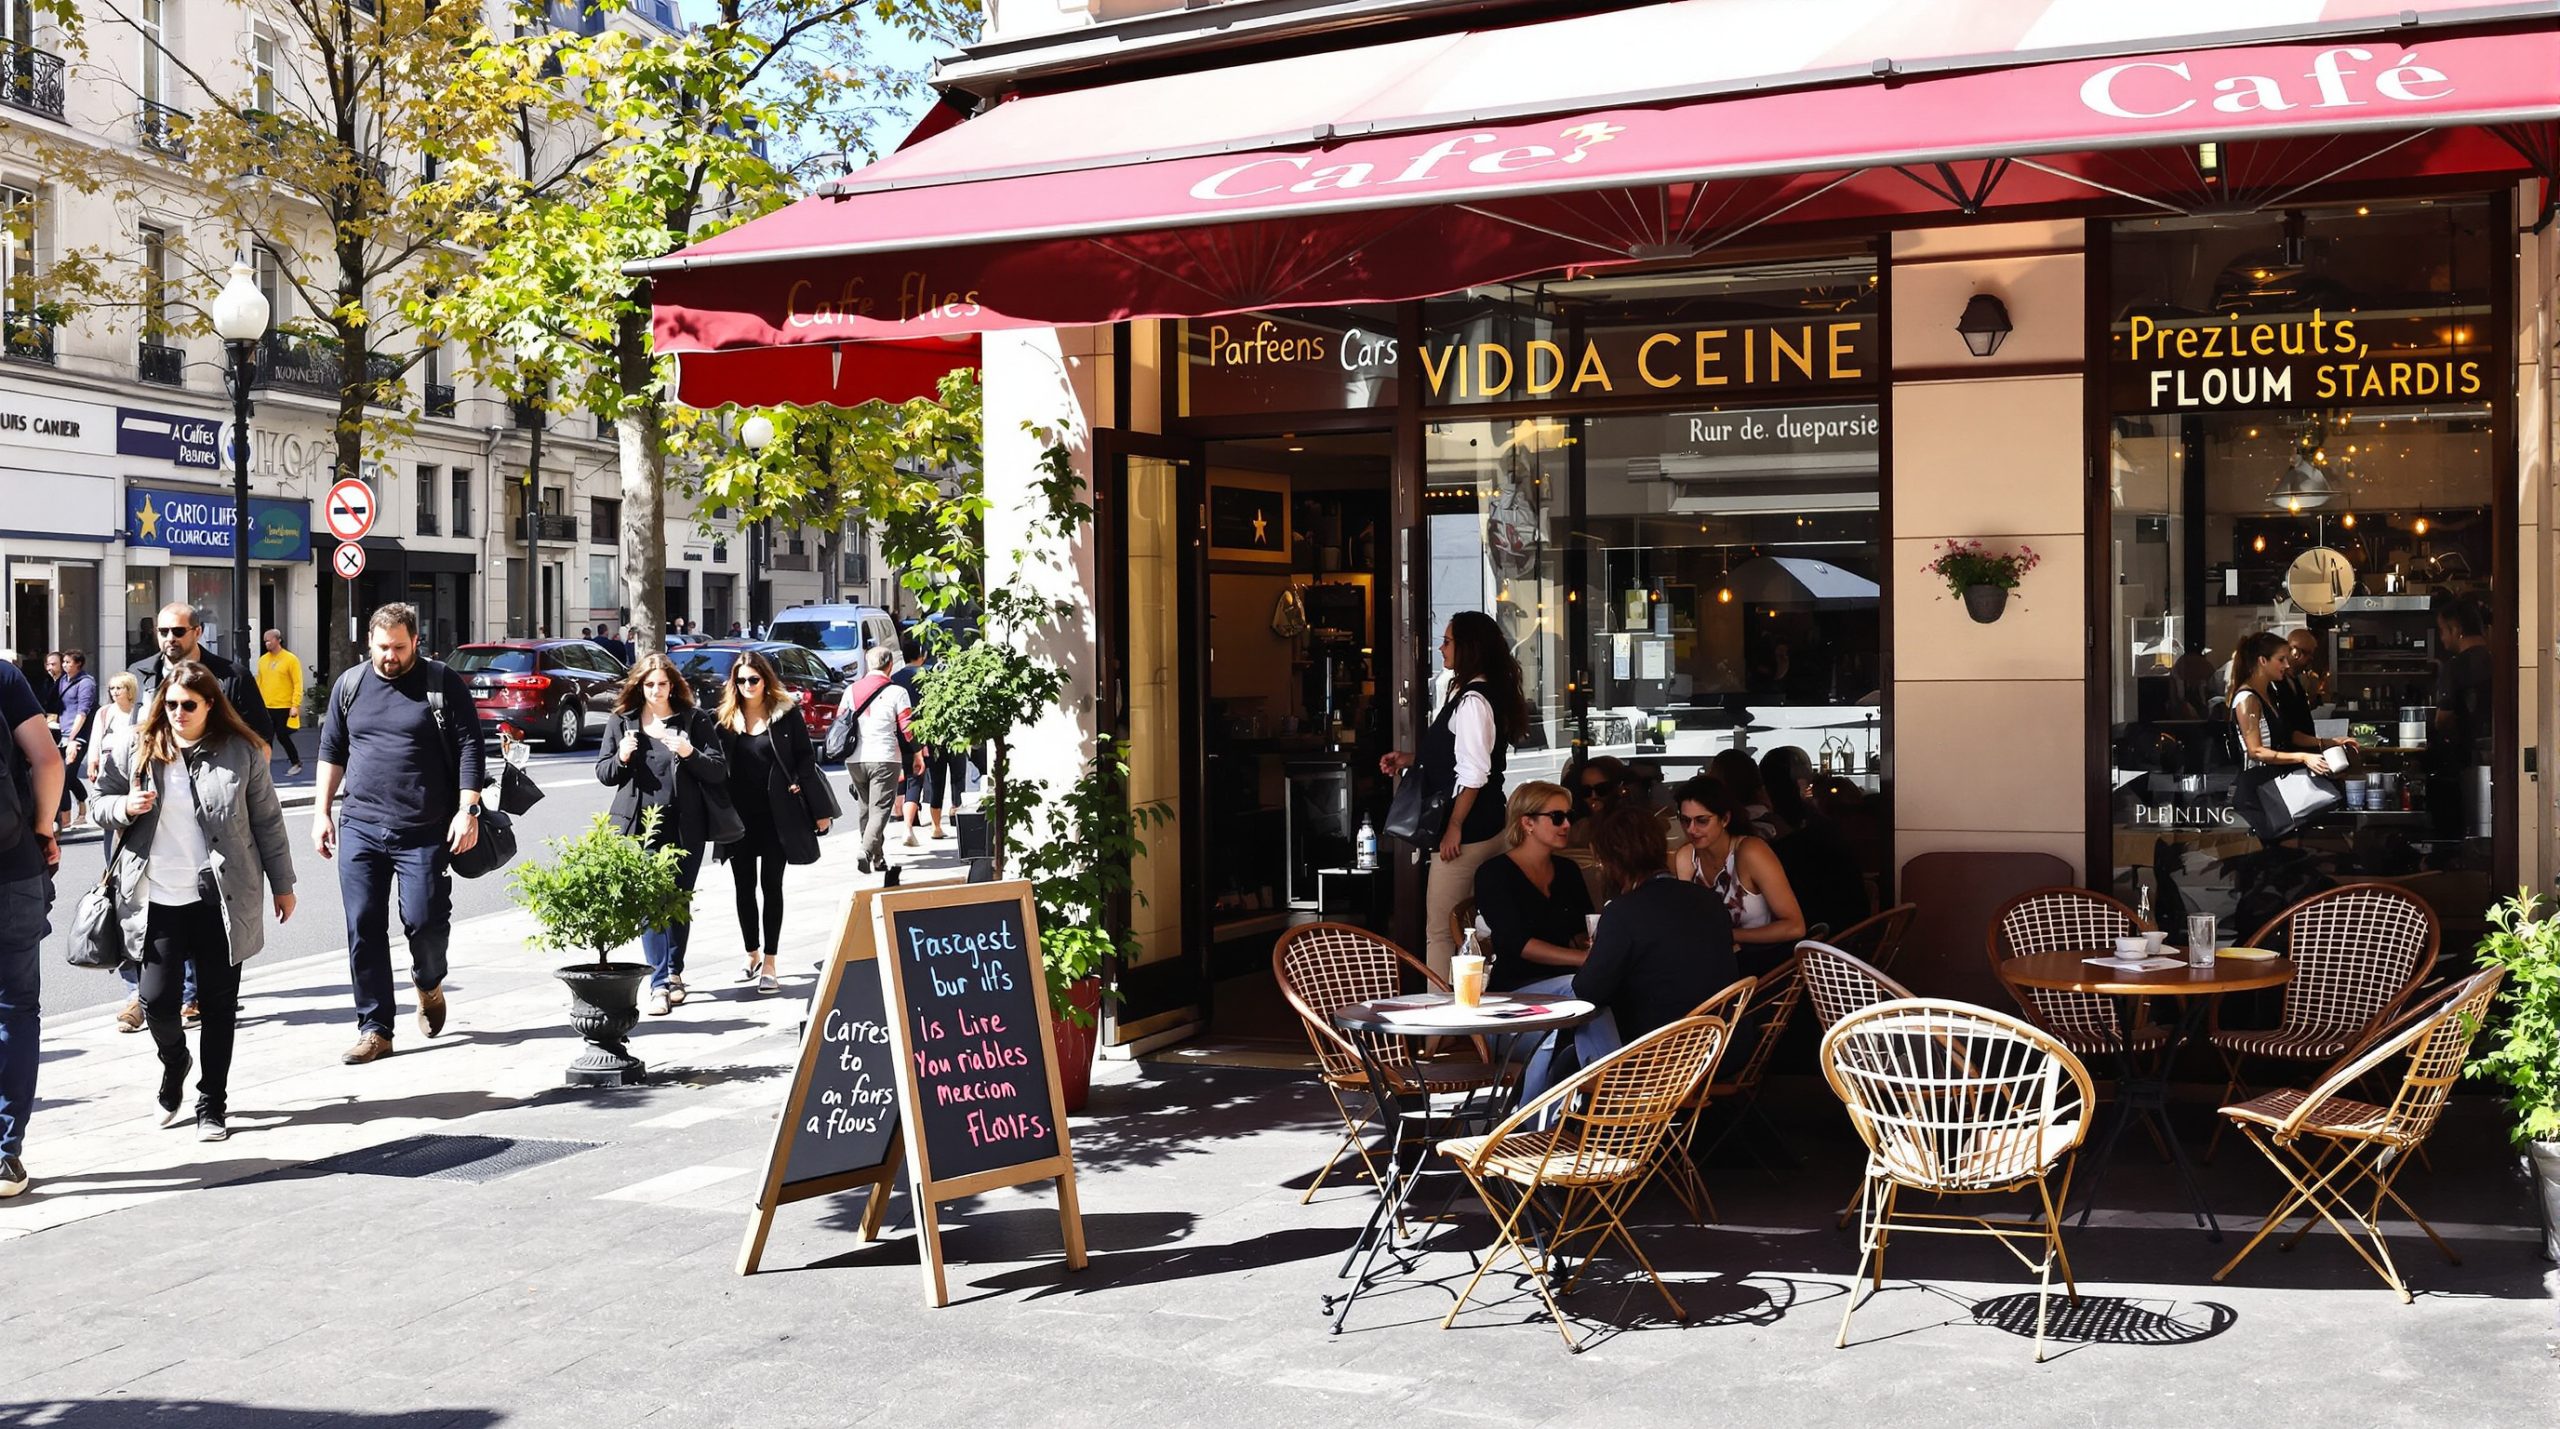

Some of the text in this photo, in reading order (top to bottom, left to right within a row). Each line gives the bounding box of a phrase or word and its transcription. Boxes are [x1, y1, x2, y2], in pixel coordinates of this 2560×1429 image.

[2079, 48, 2456, 119] Café
[1340, 328, 1398, 371] Cars
[1419, 322, 1862, 398] VIDDA CEINE
[2150, 361, 2481, 408] FLOUM STARDIS
[839, 1044, 863, 1072] to
[806, 1115, 820, 1134] a
